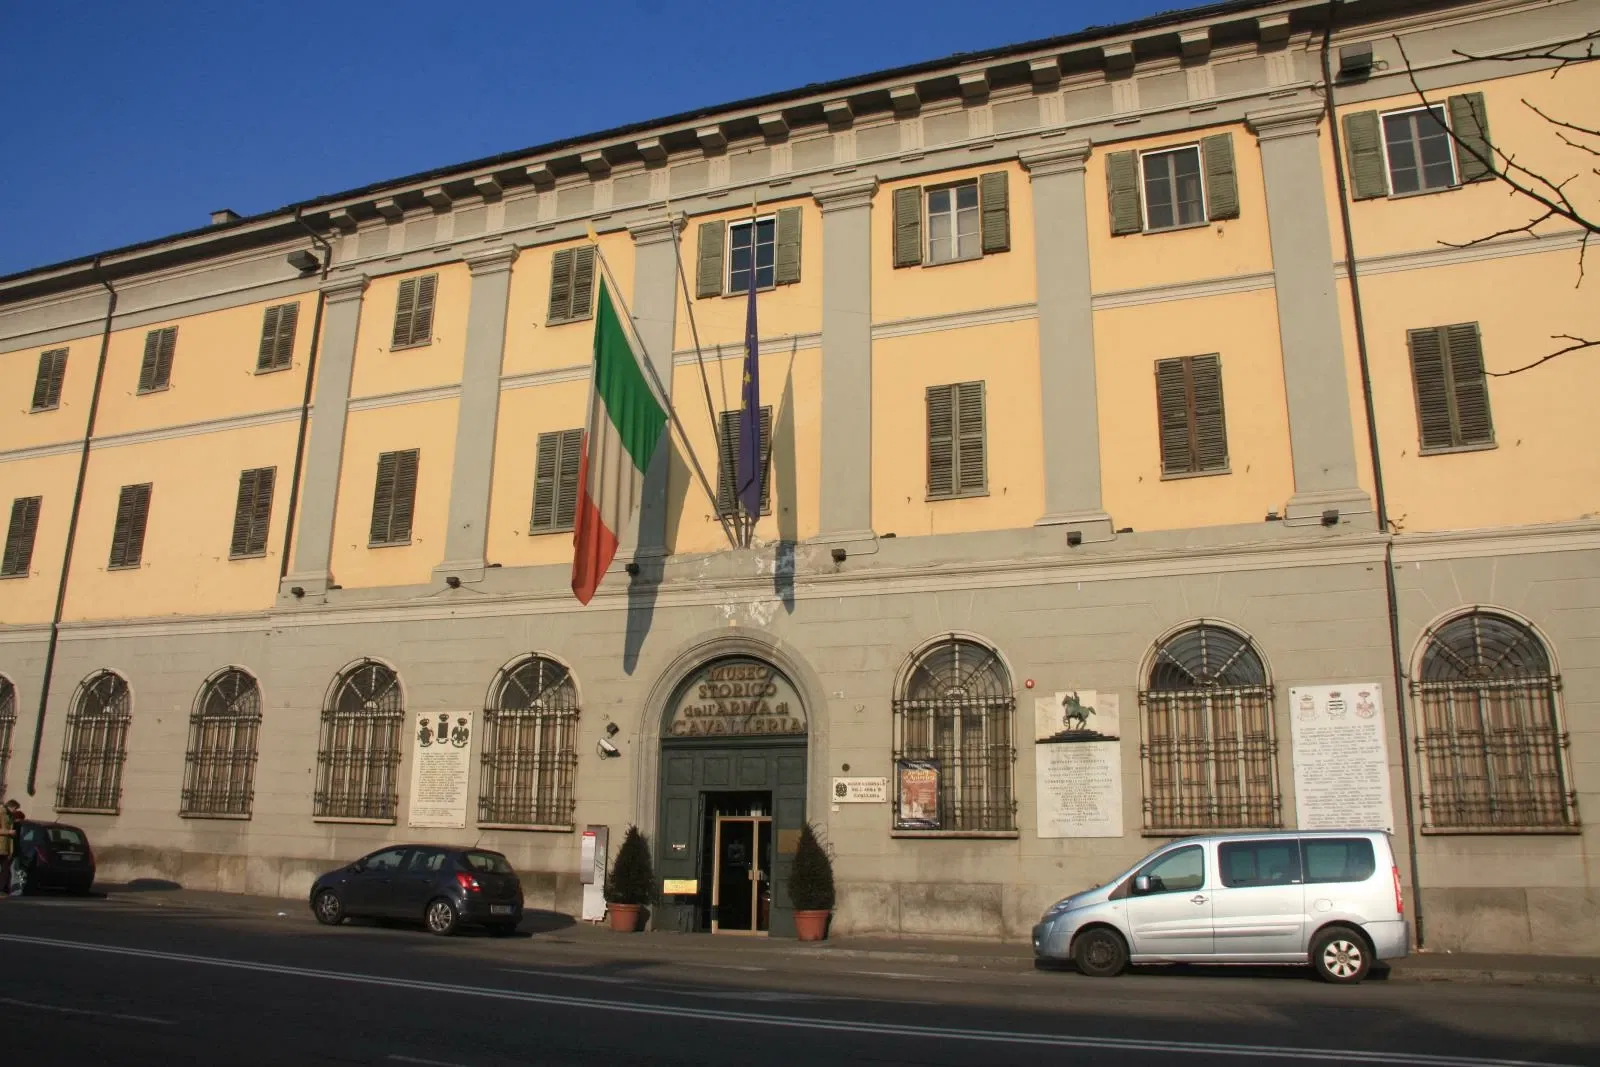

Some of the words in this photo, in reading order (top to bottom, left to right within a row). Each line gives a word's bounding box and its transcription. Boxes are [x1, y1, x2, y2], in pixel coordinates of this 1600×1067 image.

[709, 666, 769, 681] MUSEO
[698, 682, 777, 699] STORICO
[775, 701, 789, 715] di
[674, 718, 802, 735] CAVALLERIA
